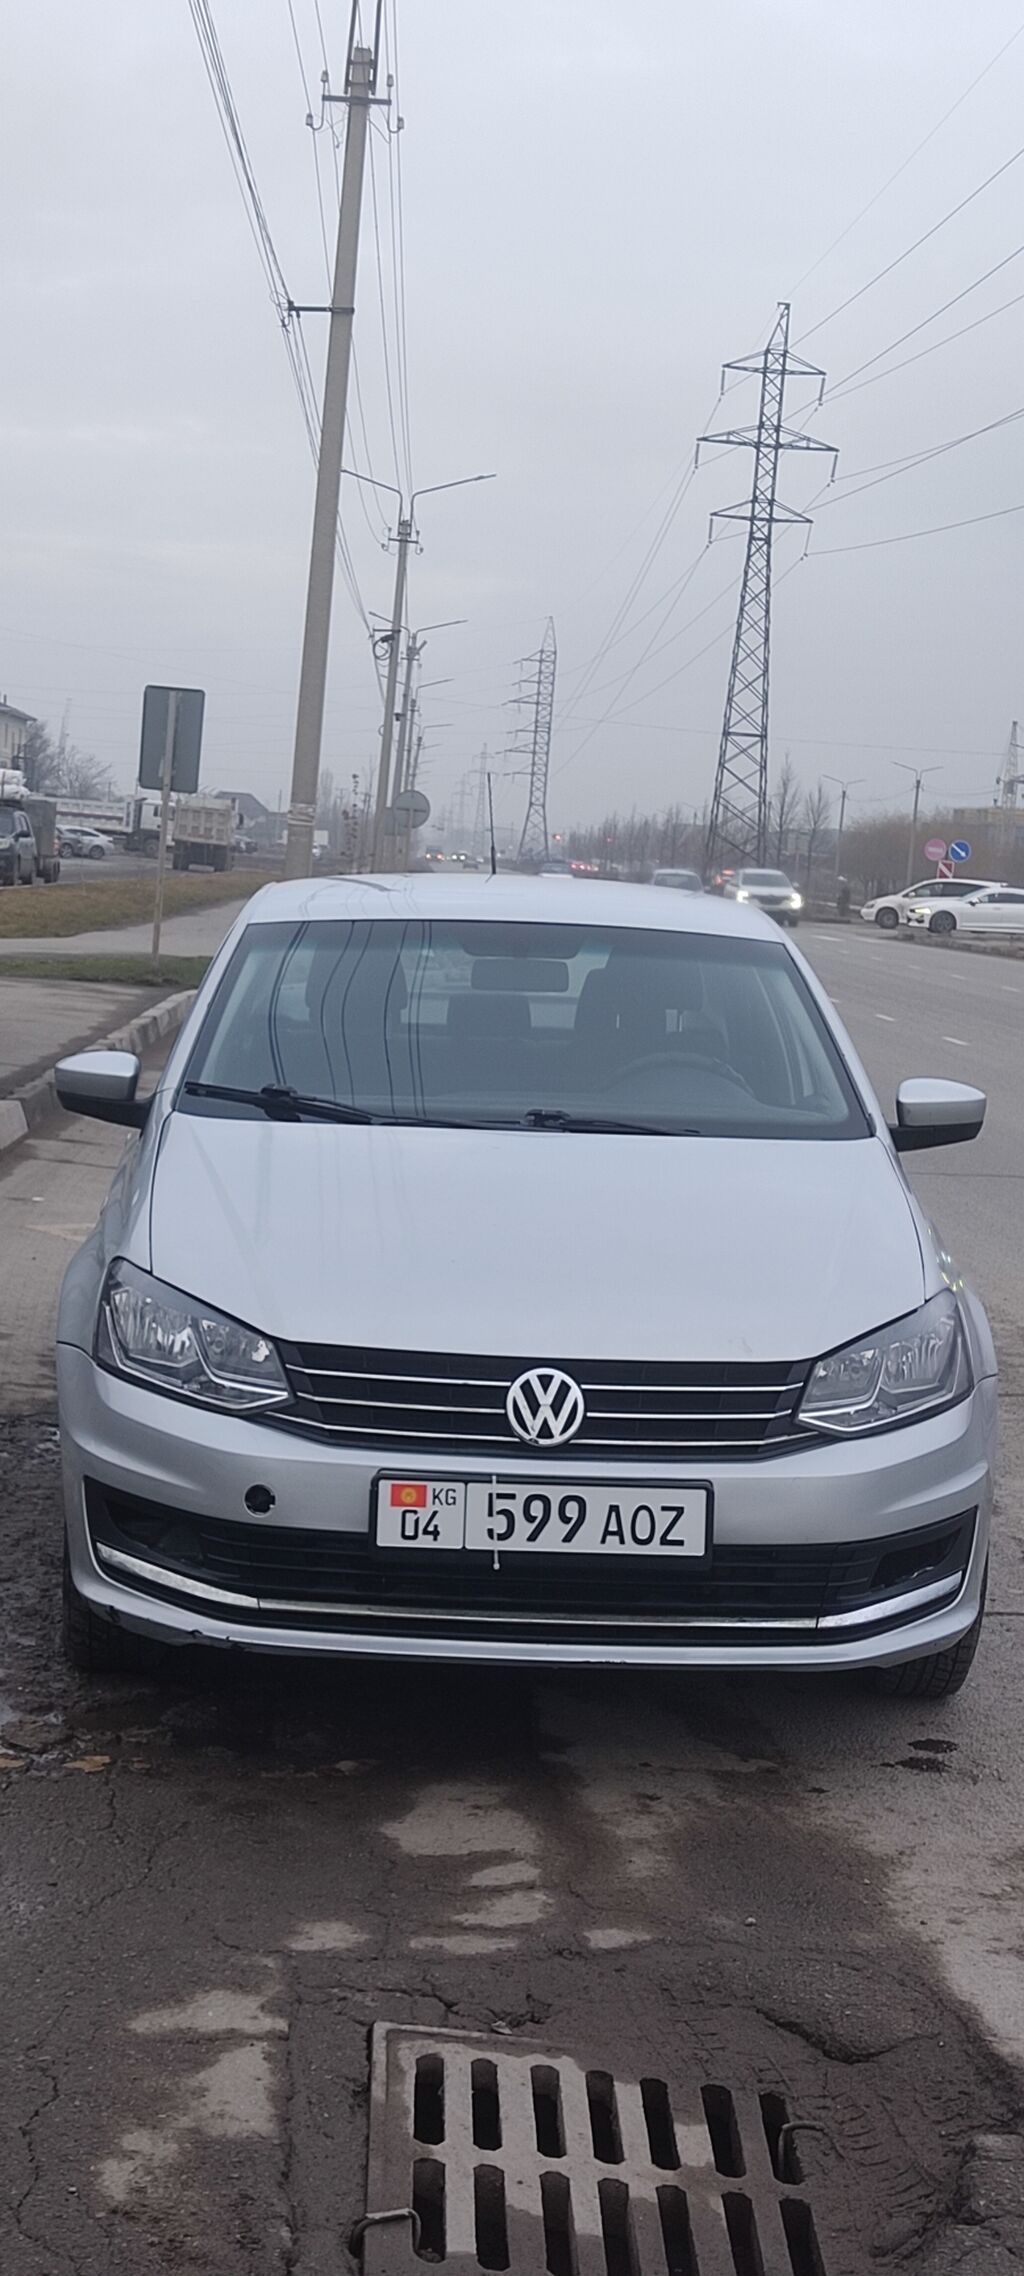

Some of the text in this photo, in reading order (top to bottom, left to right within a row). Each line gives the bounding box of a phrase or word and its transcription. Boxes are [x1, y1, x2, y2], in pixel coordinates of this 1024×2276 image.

[506, 1368, 584, 1446] VW
[431, 1488, 457, 1506] KG
[400, 1509, 440, 1541] 04
[486, 1492, 685, 1547] 599 AOZ
